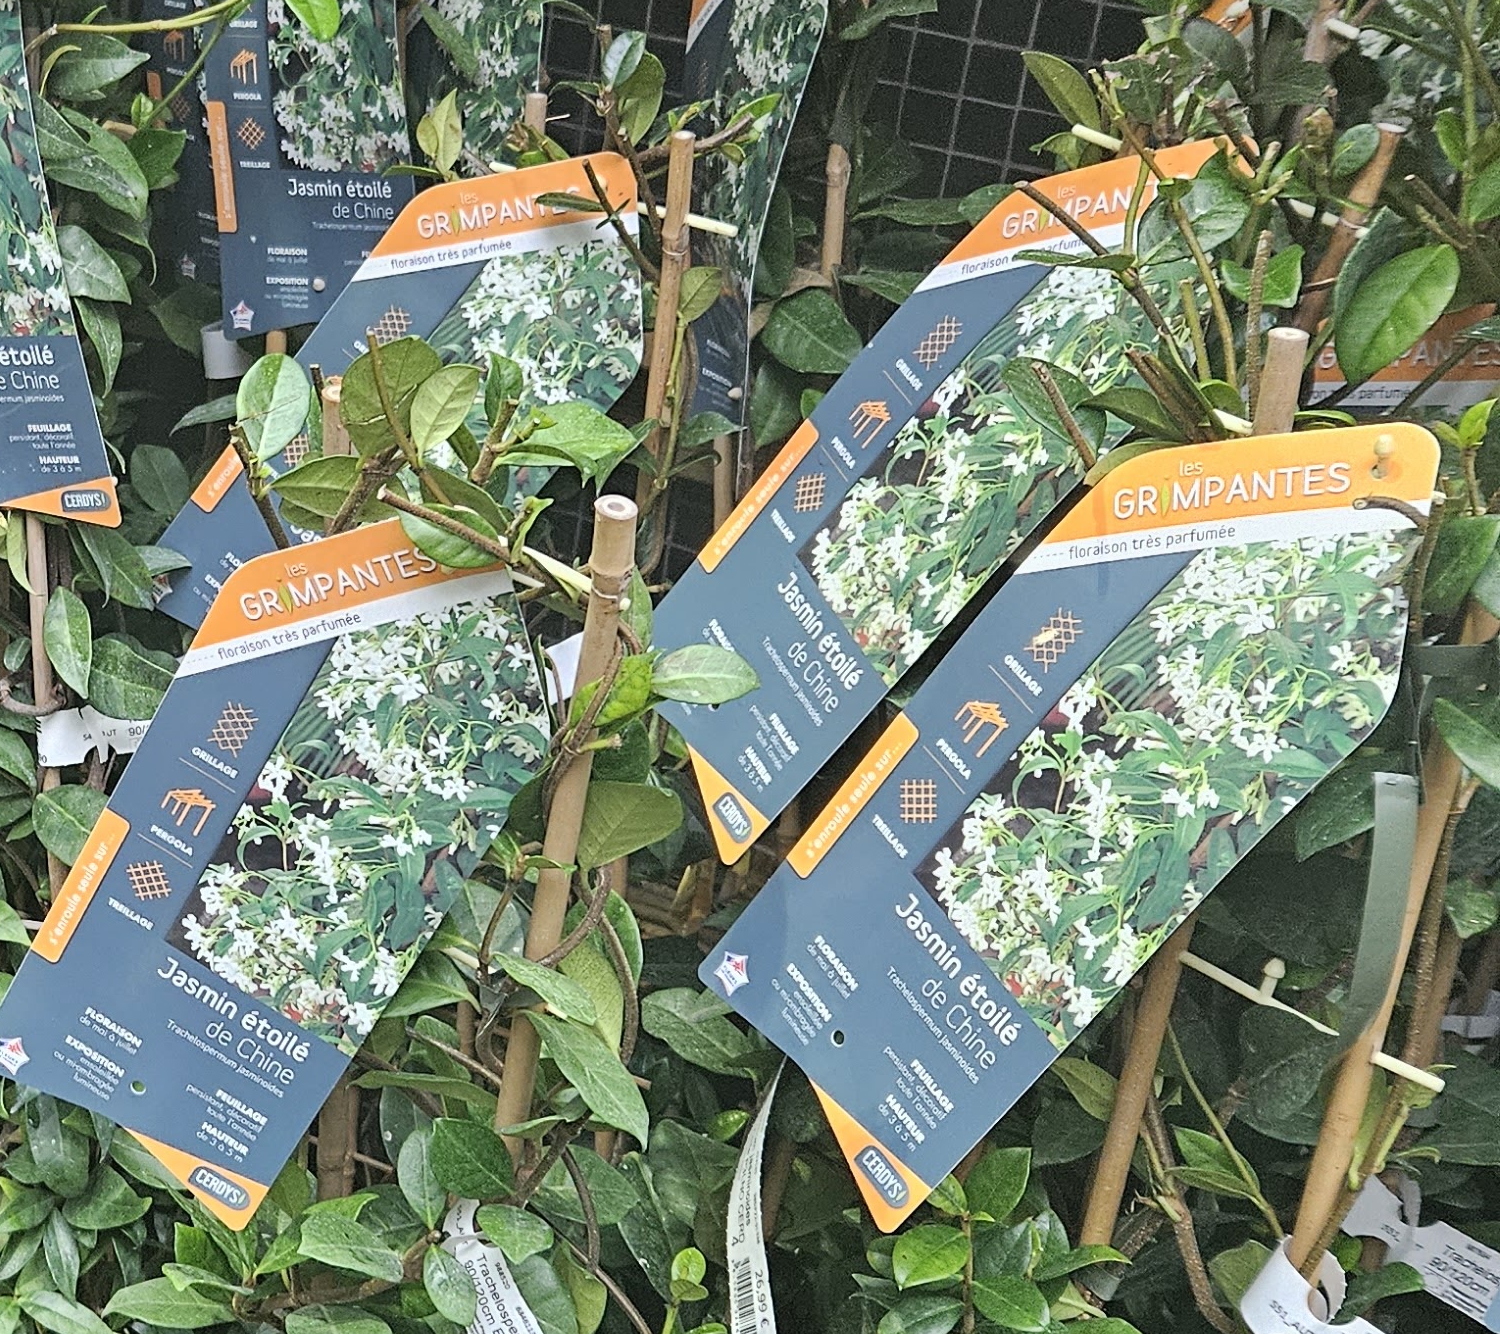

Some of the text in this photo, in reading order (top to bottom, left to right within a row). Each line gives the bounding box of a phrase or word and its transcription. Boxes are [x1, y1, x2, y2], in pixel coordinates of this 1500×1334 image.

[287, 178, 392, 199] Jasmin étoilé
[332, 202, 395, 220] de Chine
[267, 246, 308, 256] FLORAISON
[390, 239, 512, 270] floraison très parfumée
[961, 253, 1008, 275] floraison
[0, 345, 55, 366] étoilé
[895, 358, 924, 391] GRILLAGE
[10, 370, 60, 390] Chine
[28, 423, 72, 433] FEUILLAGE
[39, 455, 81, 465] HAUTEUR
[830, 435, 856, 470] PERGOLA
[1179, 460, 1204, 476] les
[1113, 462, 1352, 520] GRIMPANTES
[1069, 524, 1236, 560] floraison très parfumée
[239, 548, 437, 621] GRIMPANTES
[284, 561, 308, 579] les
[217, 613, 362, 660] floraison très parfumée
[778, 571, 864, 691] Jasmin étoilé
[787, 641, 840, 714] de Chine
[1004, 653, 1044, 698] GRILLAGE
[769, 712, 800, 756] FEUILLAGE
[191, 747, 239, 779] GRILLAGE
[744, 746, 773, 786] HAUTEUR
[935, 738, 973, 781] PERGOLA
[850, 769, 877, 805] seule
[150, 824, 194, 857] PERGOLA
[871, 813, 909, 859] TREILLAGE
[78, 862, 99, 894] seule
[107, 896, 155, 931] TREILLAGE
[814, 934, 860, 992] FLORAISON
[895, 893, 1022, 1048] Jasmin étoilé
[157, 957, 311, 1064] Jasmin étoilé
[786, 962, 832, 1023] EXPOSITION
[85, 1006, 143, 1049] FLORAISON
[886, 966, 981, 1086] Trachelospermum jasminoides
[921, 977, 997, 1071] de Chine
[65, 1034, 126, 1078] EXPOSITION
[166, 1019, 285, 1099] Trachelospermum jasminoides
[205, 1020, 296, 1085] de Chine
[911, 1058, 955, 1114] FEUILLAGE
[215, 1088, 269, 1127] FEUILLAGE
[884, 1093, 926, 1146] HAUTEUR
[201, 1121, 250, 1156] HAUTEUR
[754, 1268, 768, 1313] 26,99
